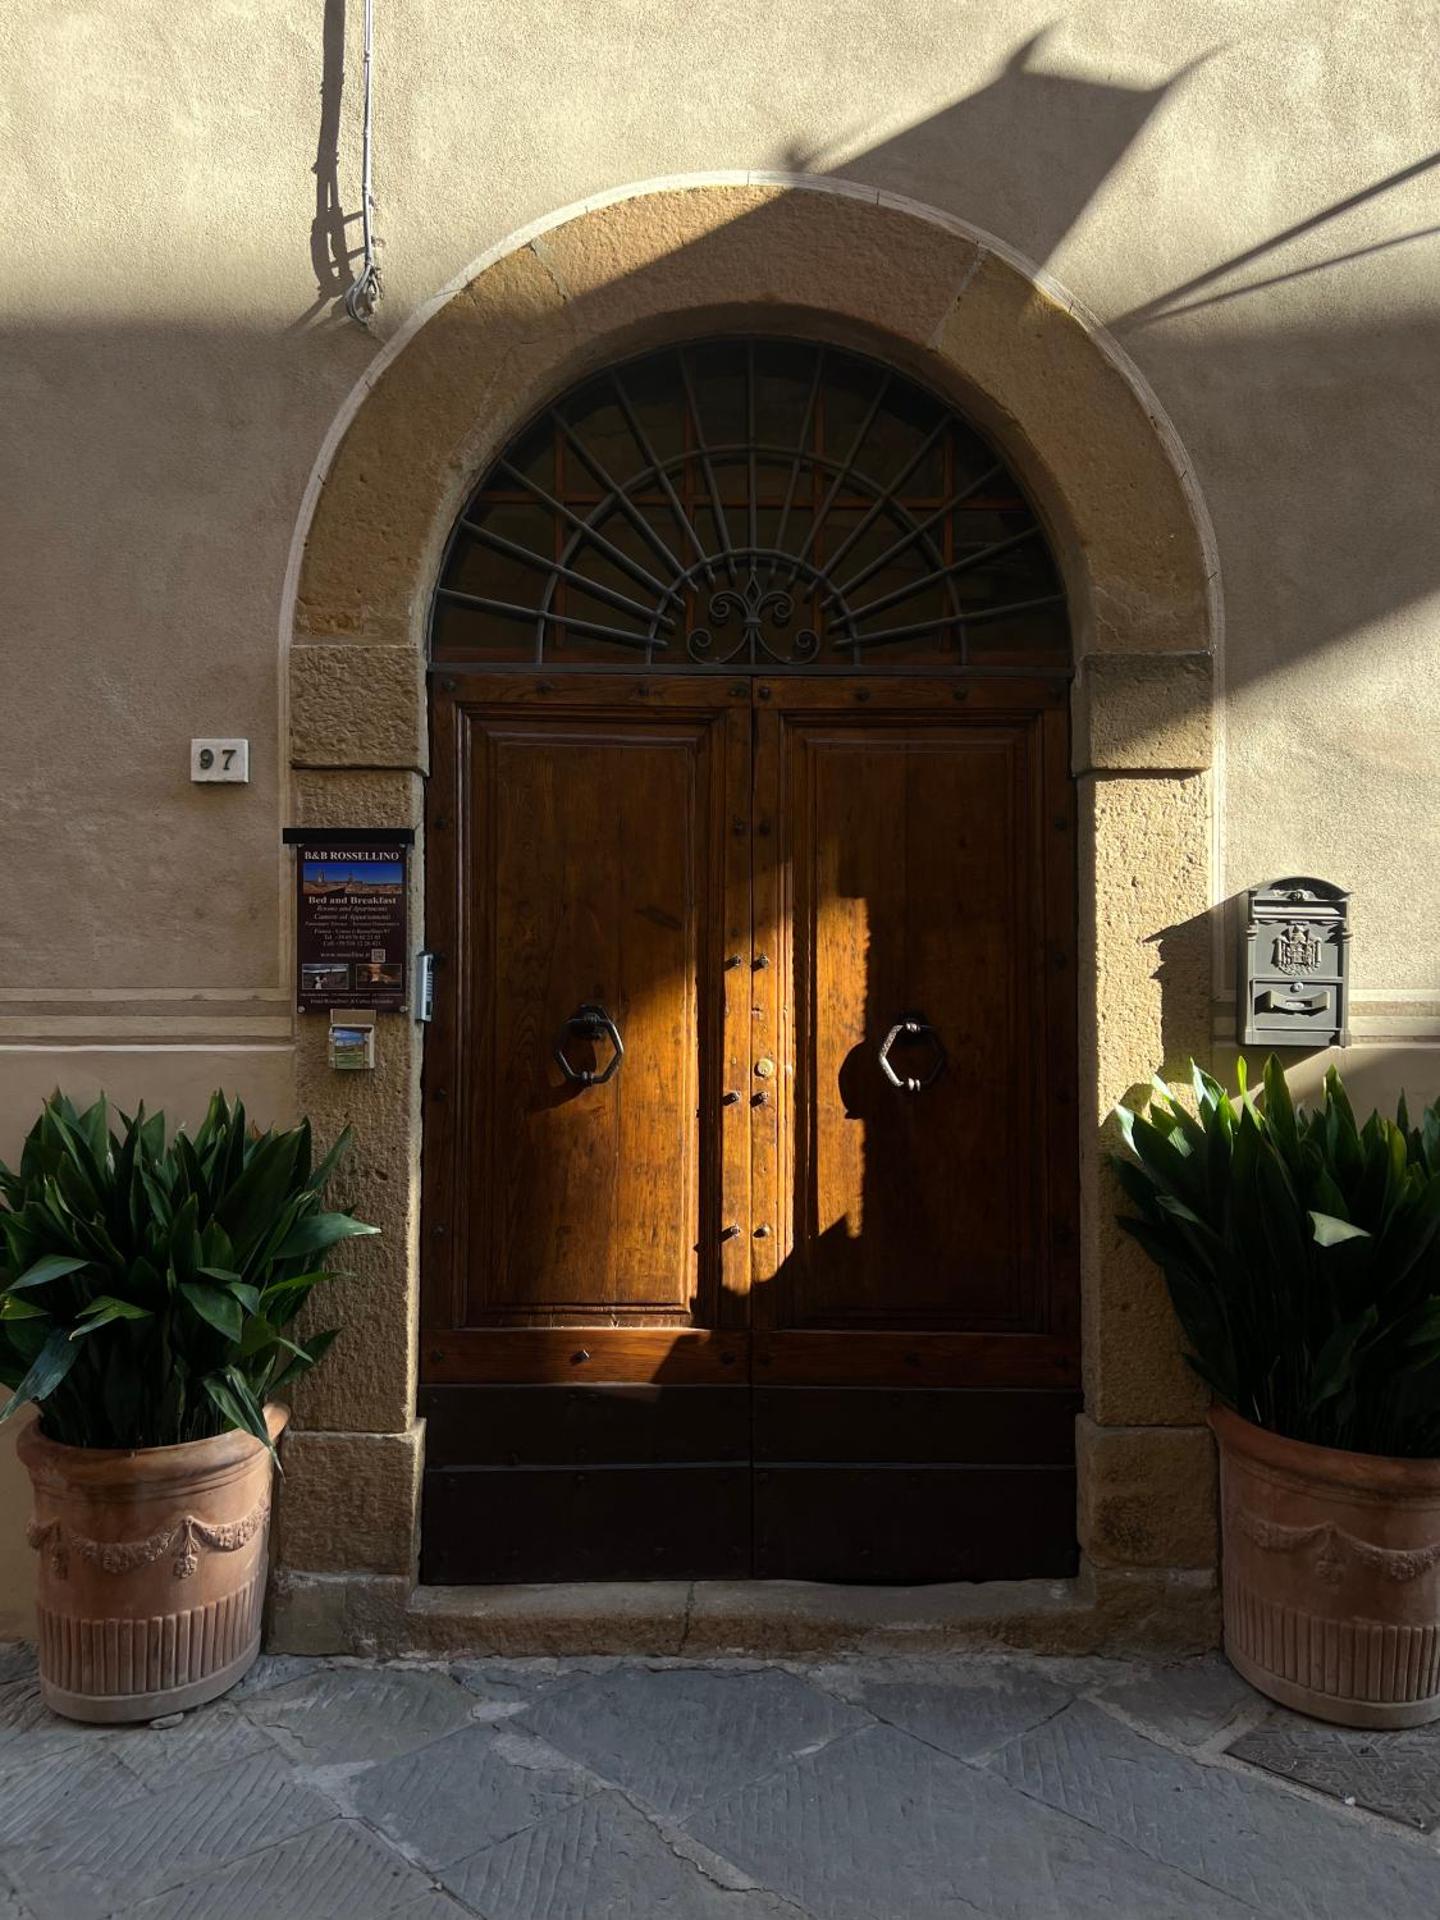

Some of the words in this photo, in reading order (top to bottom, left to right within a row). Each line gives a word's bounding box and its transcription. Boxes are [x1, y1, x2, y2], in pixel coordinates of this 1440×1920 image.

[200, 749, 237, 770] 97
[304, 851, 328, 861] B&B
[330, 851, 400, 861] ROSSELLINO
[308, 896, 327, 904] Bed
[329, 896, 348, 904] and
[350, 896, 397, 904] Breakfast
